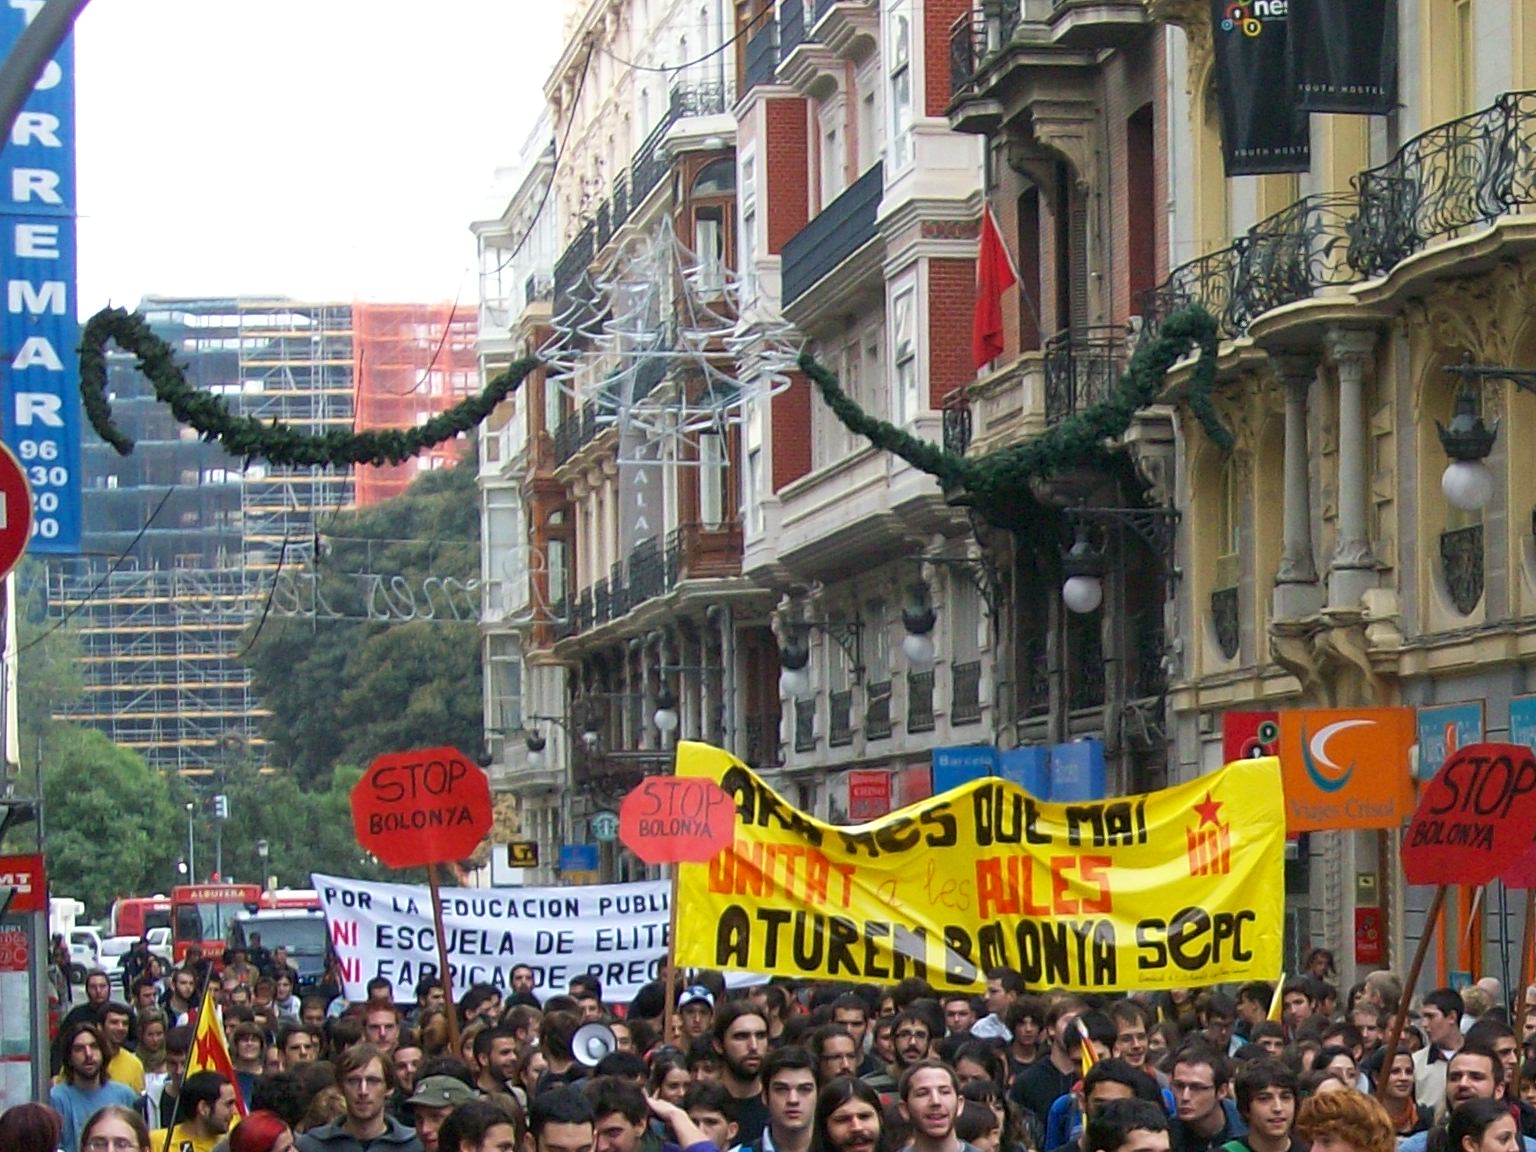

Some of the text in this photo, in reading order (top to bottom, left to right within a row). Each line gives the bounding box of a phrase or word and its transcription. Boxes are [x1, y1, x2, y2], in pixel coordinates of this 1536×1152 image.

[19, 440, 58, 460] 96
[371, 759, 468, 803] STOP
[642, 780, 724, 820] STOP
[368, 805, 474, 835] BOLONYA
[639, 818, 713, 839] BOLONYA
[1410, 820, 1496, 851] BOLONYA
[325, 887, 372, 911] POR
[392, 897, 419, 915] LA
[441, 897, 580, 919] EDUCACION
[333, 920, 358, 947] NI
[375, 923, 515, 957] ESCUELA
[534, 930, 575, 956] DE
[715, 904, 928, 981] ATUREM
[340, 957, 361, 984] NI
